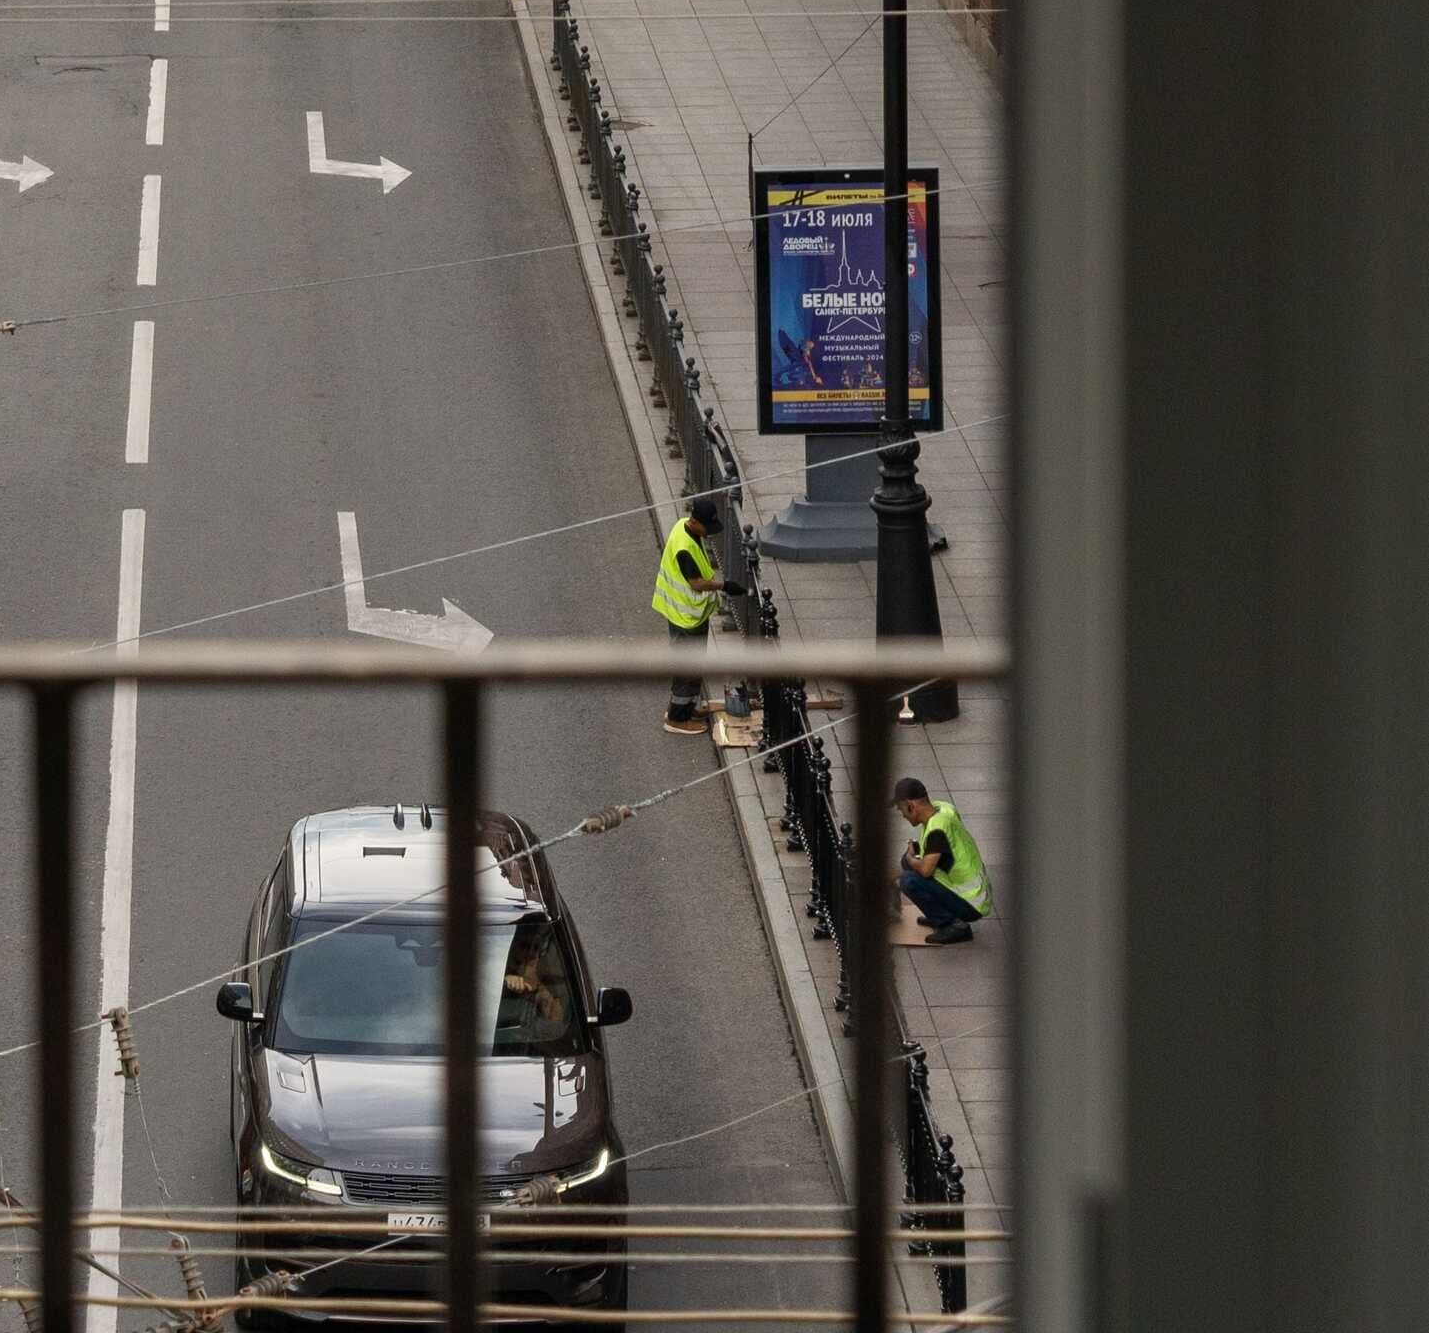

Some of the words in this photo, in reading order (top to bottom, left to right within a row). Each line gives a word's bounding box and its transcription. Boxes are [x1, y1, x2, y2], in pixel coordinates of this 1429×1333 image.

[782, 210, 825, 227] 17-18
[832, 213, 873, 227] ИЮЛЯ
[783, 235, 823, 244] ЛЕДОВЫЙ
[802, 293, 857, 308] БЕЛЫЕ
[860, 292, 885, 307] НО
[819, 333, 885, 342] МЕЖДУНАРОДНЫЙ
[824, 343, 879, 351] МУЗЫКАЛЬНЫЙ
[822, 354, 864, 362] ФЕСТИВАЛЬ
